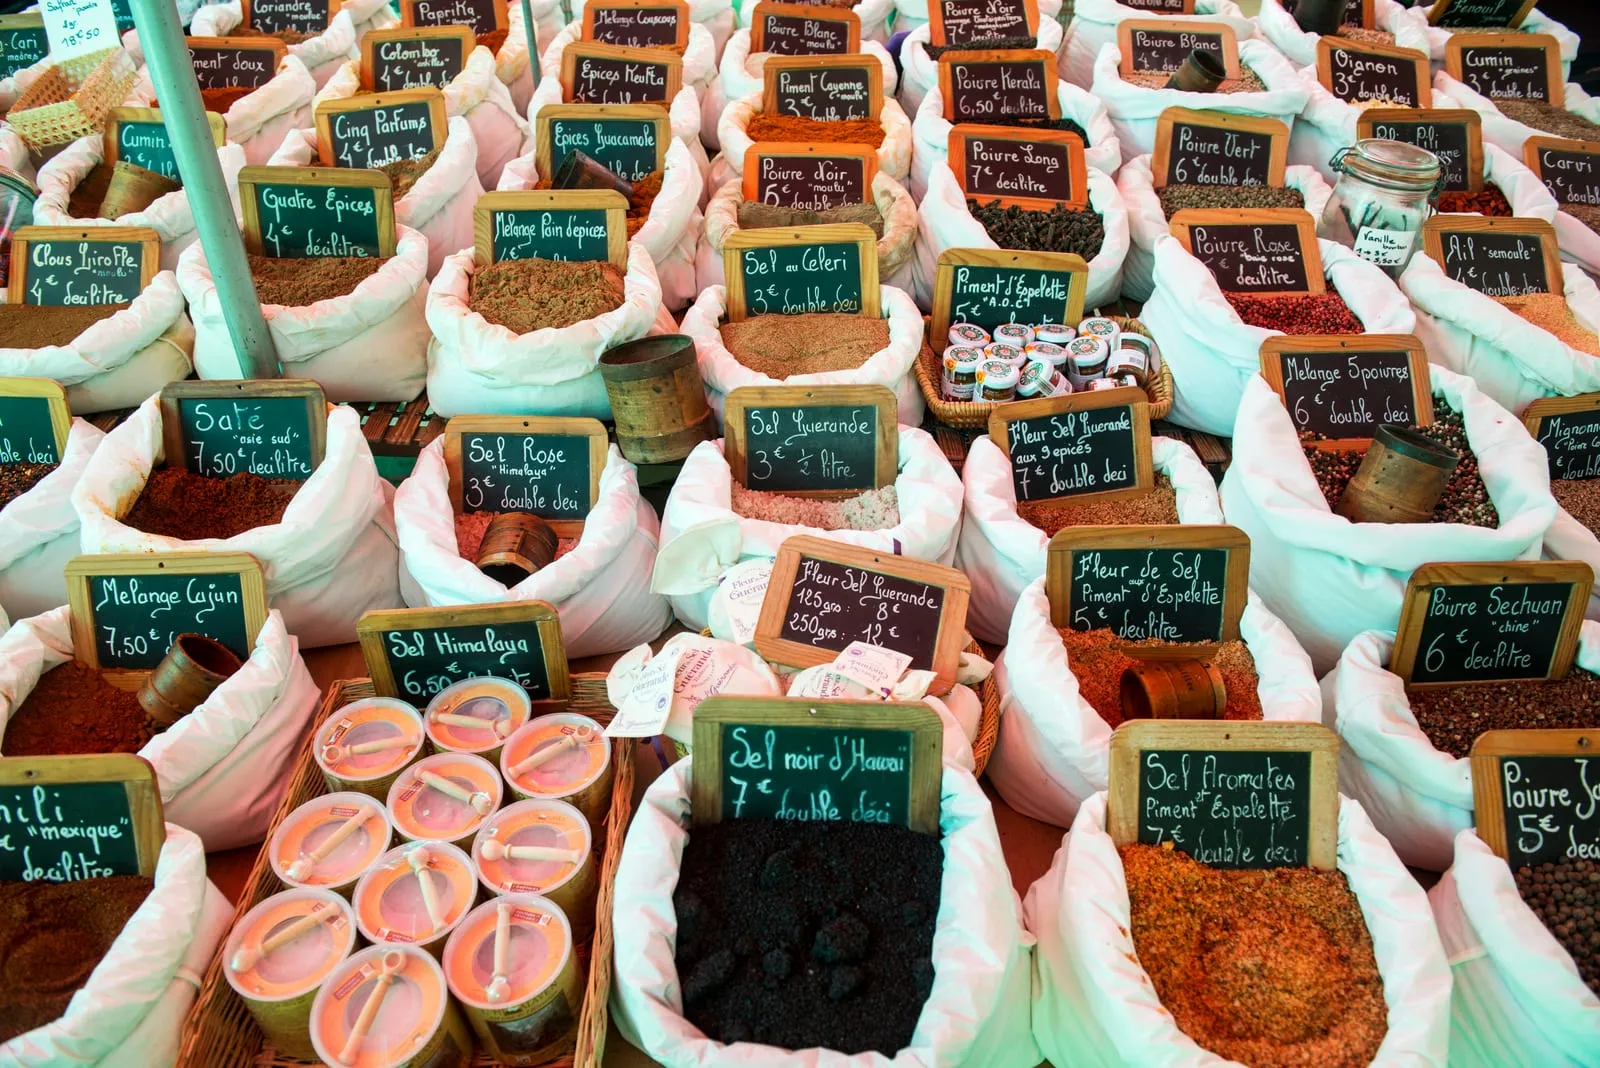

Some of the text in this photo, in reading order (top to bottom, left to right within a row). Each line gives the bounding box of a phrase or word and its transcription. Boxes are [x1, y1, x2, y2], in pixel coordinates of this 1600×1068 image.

[945, 2, 981, 17] Poivre
[768, 16, 838, 41] Poivre Blanc
[1136, 31, 1220, 51] Poivre Blanc
[233, 51, 265, 72] doux
[380, 42, 440, 61] Colombo
[1335, 49, 1397, 78] Oignon
[1466, 51, 1513, 68] Cumin
[402, 71, 435, 90] double
[780, 71, 864, 100] Piment Cayenne
[956, 66, 1041, 91] Poivre Kerala
[1490, 81, 1544, 99] double deci
[1000, 98, 1045, 114] decilitre
[1358, 83, 1391, 102] double
[1393, 87, 1411, 106] deci
[810, 105, 841, 122] double
[122, 124, 166, 149] Cumin
[335, 115, 371, 146] Cinq
[594, 123, 655, 155] Guacamole
[1179, 126, 1262, 160] Poivre Vert
[367, 144, 402, 169] double
[763, 158, 806, 181] Poivre
[973, 140, 1059, 173] Poivre Long
[1543, 150, 1592, 173] Carvi
[996, 171, 1047, 193] decilitre
[1197, 163, 1238, 186] double
[263, 187, 317, 224] Quatre
[790, 192, 832, 211] double
[306, 228, 369, 258] décilitre
[494, 211, 563, 249] Melange Pain
[1195, 226, 1295, 255] Poivre Rose
[1363, 230, 1396, 244] Vanille
[32, 243, 73, 268] Clous
[745, 246, 847, 275] Sel au Celeri
[1446, 234, 1536, 264] Ail "semoule"
[957, 267, 1067, 302] Piment d'Espelette
[1236, 264, 1295, 286] decilitre
[63, 281, 129, 306] decilitre
[782, 285, 828, 315] double
[833, 284, 858, 312] deci
[1285, 357, 1342, 392] Melange
[195, 402, 265, 432] Saté
[1329, 395, 1409, 424] double deci
[751, 409, 871, 446] Sel Guerande
[1008, 411, 1132, 455] Fleur Sel Guerande
[28, 436, 54, 464] deci
[248, 449, 312, 475] decilitre
[468, 436, 566, 465] Sel Rose
[820, 448, 856, 480] litre
[1016, 454, 1037, 464] aux
[491, 463, 556, 484] "Himalaya"
[1050, 462, 1097, 494] double
[1103, 457, 1128, 484] deci
[500, 485, 546, 509] double
[552, 484, 578, 511] deci
[1075, 550, 1201, 581] Fleur de Sel
[795, 559, 939, 609] Fleur Sel Guerande
[1082, 580, 1222, 612] Piment d'Espelette
[96, 578, 238, 624] Melange Cajun
[1430, 586, 1563, 617] Poivre Sechuan
[1119, 609, 1183, 639] decilitre
[1491, 619, 1540, 634] "chine"
[389, 628, 528, 665] Sel Himalaya
[1464, 641, 1532, 670] decilitre
[730, 727, 774, 771] Sel
[784, 745, 825, 771] noir
[1146, 753, 1296, 792] Sel Aromates
[1503, 760, 1572, 809] Poivre
[774, 788, 842, 822] double
[1146, 793, 1297, 830] Piment Espelette
[26, 816, 128, 856] "mexique"
[1192, 822, 1300, 866] double deci
[22, 845, 114, 883] decilitre
